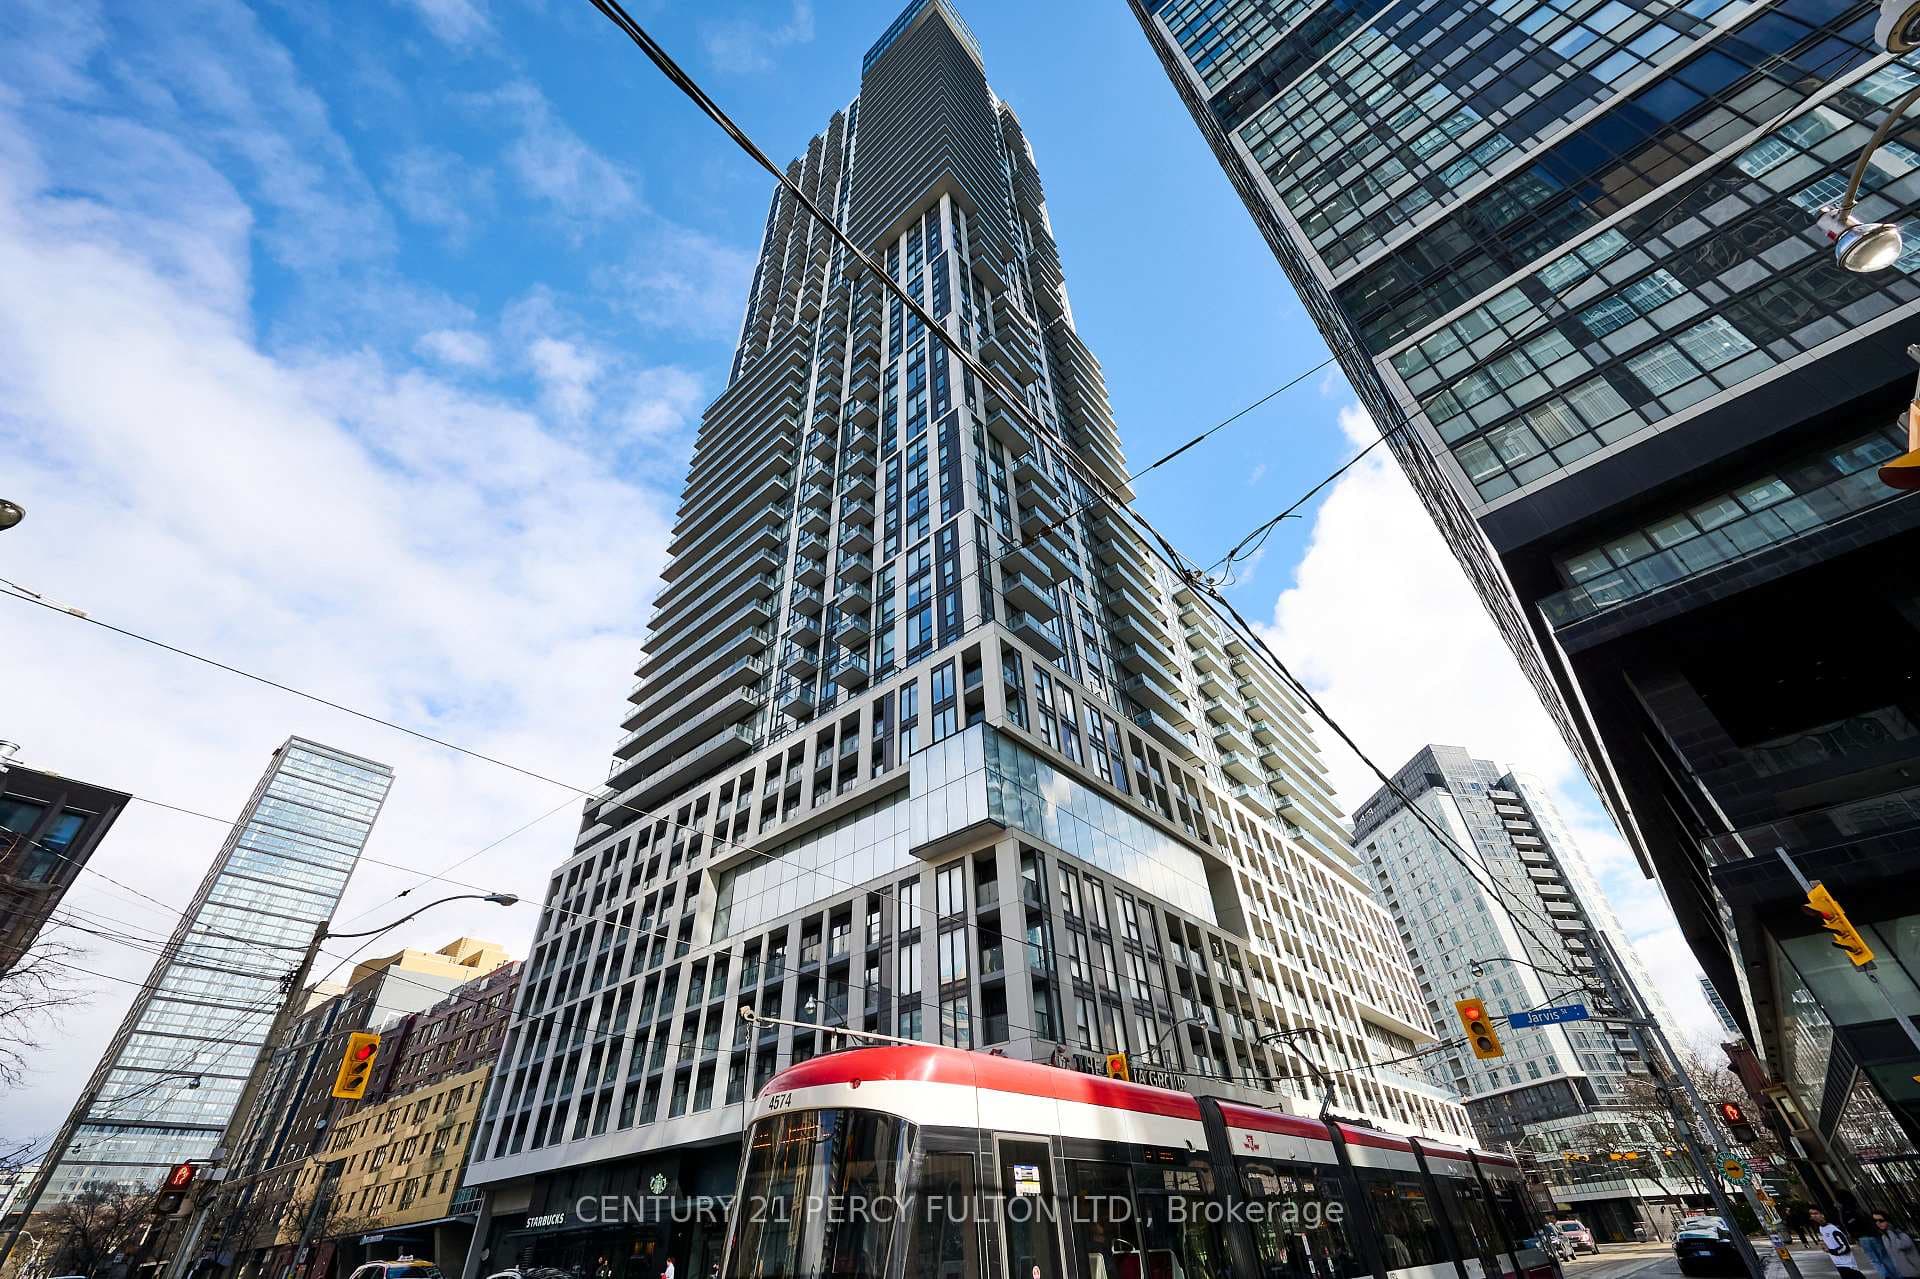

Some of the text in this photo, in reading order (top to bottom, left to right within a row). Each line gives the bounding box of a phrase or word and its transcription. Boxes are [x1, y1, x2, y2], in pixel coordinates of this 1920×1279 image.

[1527, 1010, 1560, 1024] Jarvis
[768, 1092, 792, 1111] 4574
[526, 1212, 565, 1229] STARBUCKS
